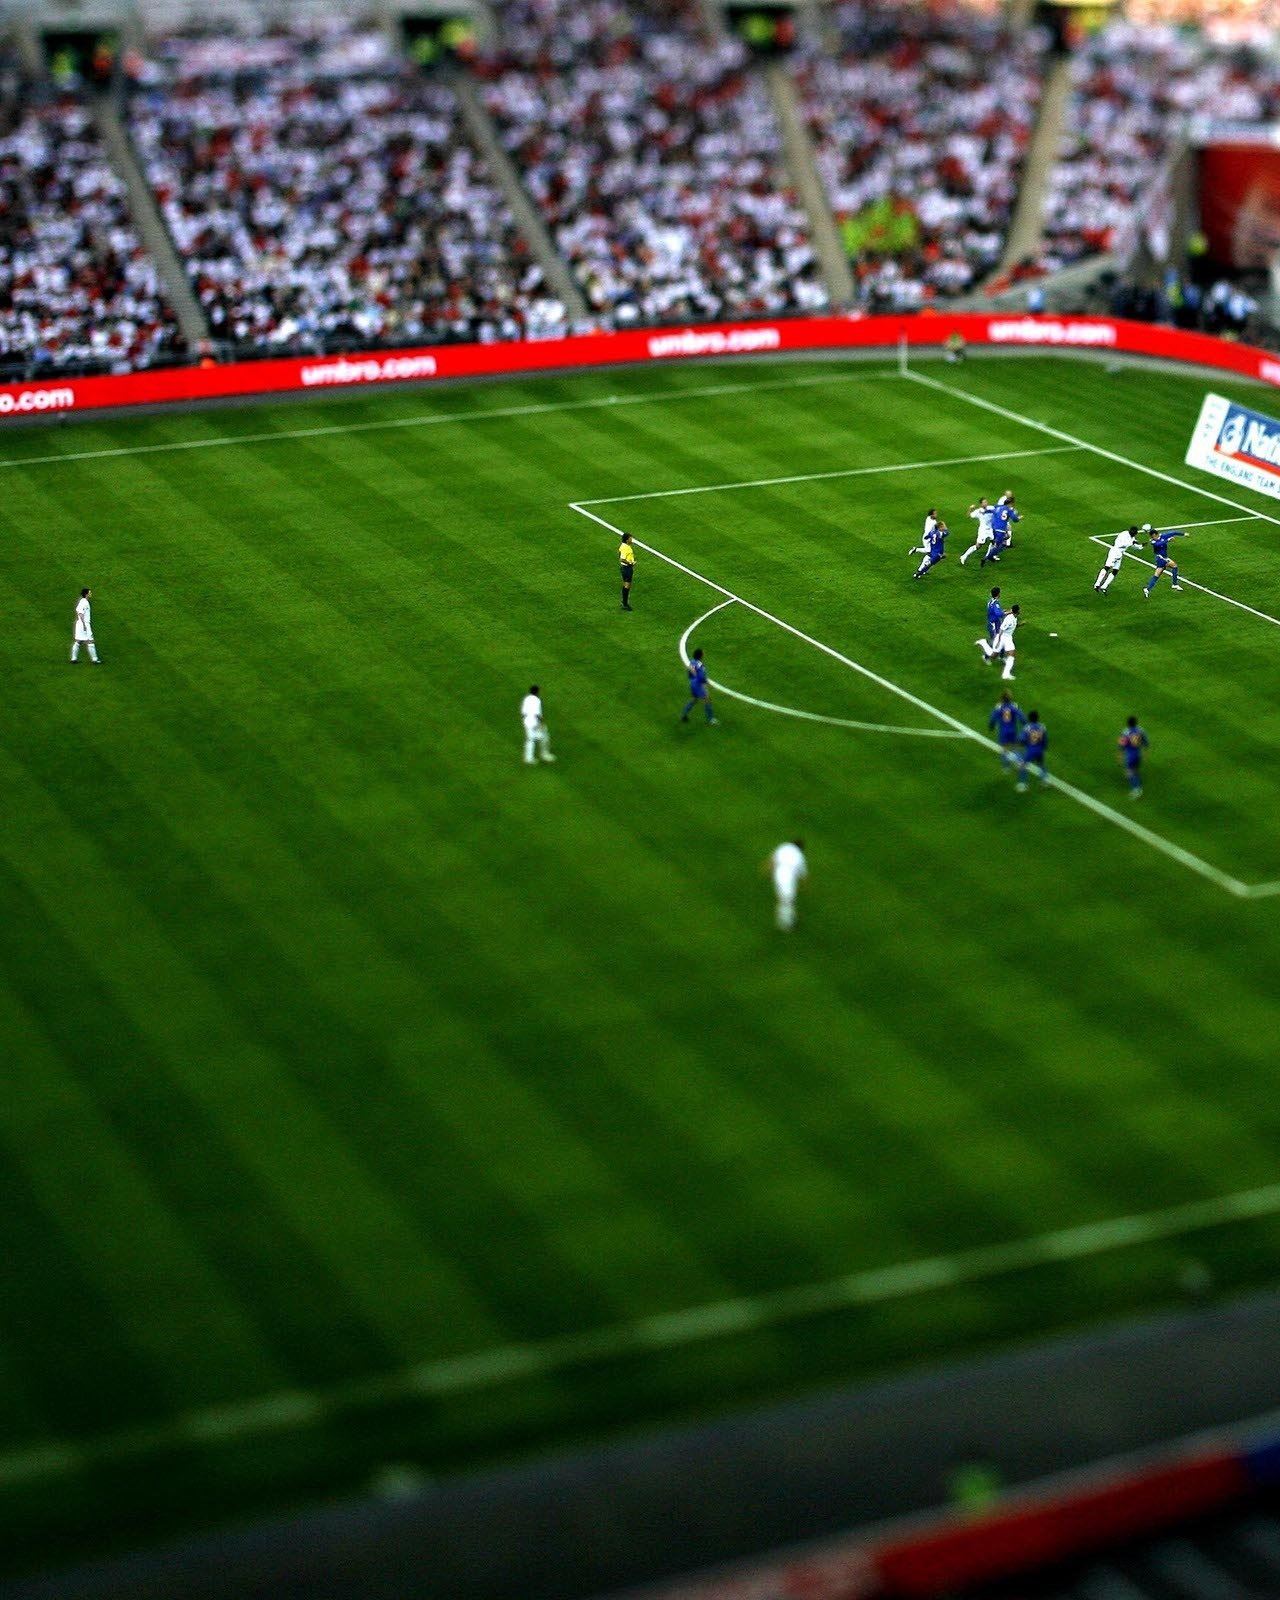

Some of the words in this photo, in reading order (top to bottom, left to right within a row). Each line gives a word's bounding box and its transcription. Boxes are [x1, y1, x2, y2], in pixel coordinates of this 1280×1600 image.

[301, 356, 437, 386] umbro.com
[1220, 462, 1253, 482] ENGLAND
[1256, 475, 1275, 489] TEAM
